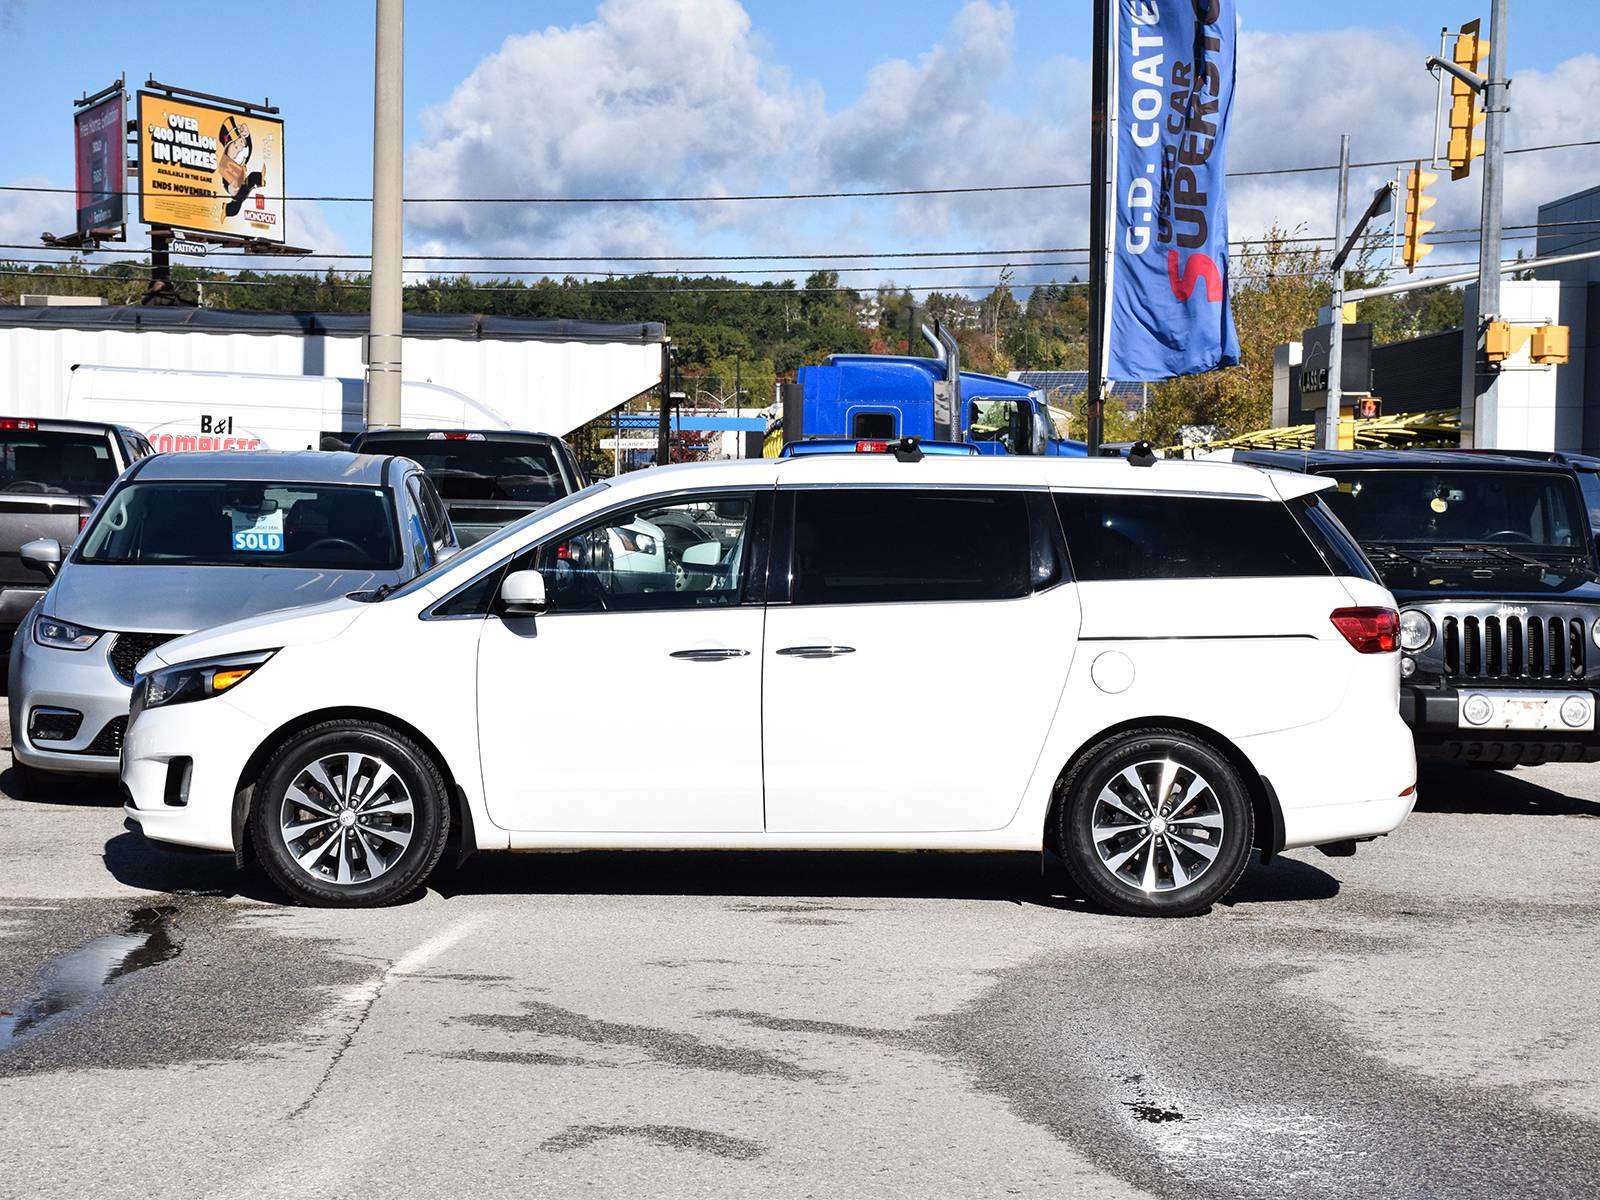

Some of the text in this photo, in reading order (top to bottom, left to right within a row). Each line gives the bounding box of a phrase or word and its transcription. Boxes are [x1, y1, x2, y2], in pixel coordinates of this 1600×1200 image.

[1167, 60, 1192, 135] CAR
[168, 114, 199, 131] OVER
[174, 130, 217, 151] MILLION
[153, 141, 218, 169] IN PRIZES
[152, 180, 172, 192] ENDS
[173, 183, 212, 197] NOVEMBER
[244, 210, 276, 224] MONOPOLY
[1126, 164, 1154, 255] G.D.
[174, 242, 205, 253] PATTISON
[235, 533, 280, 550] SOLD
